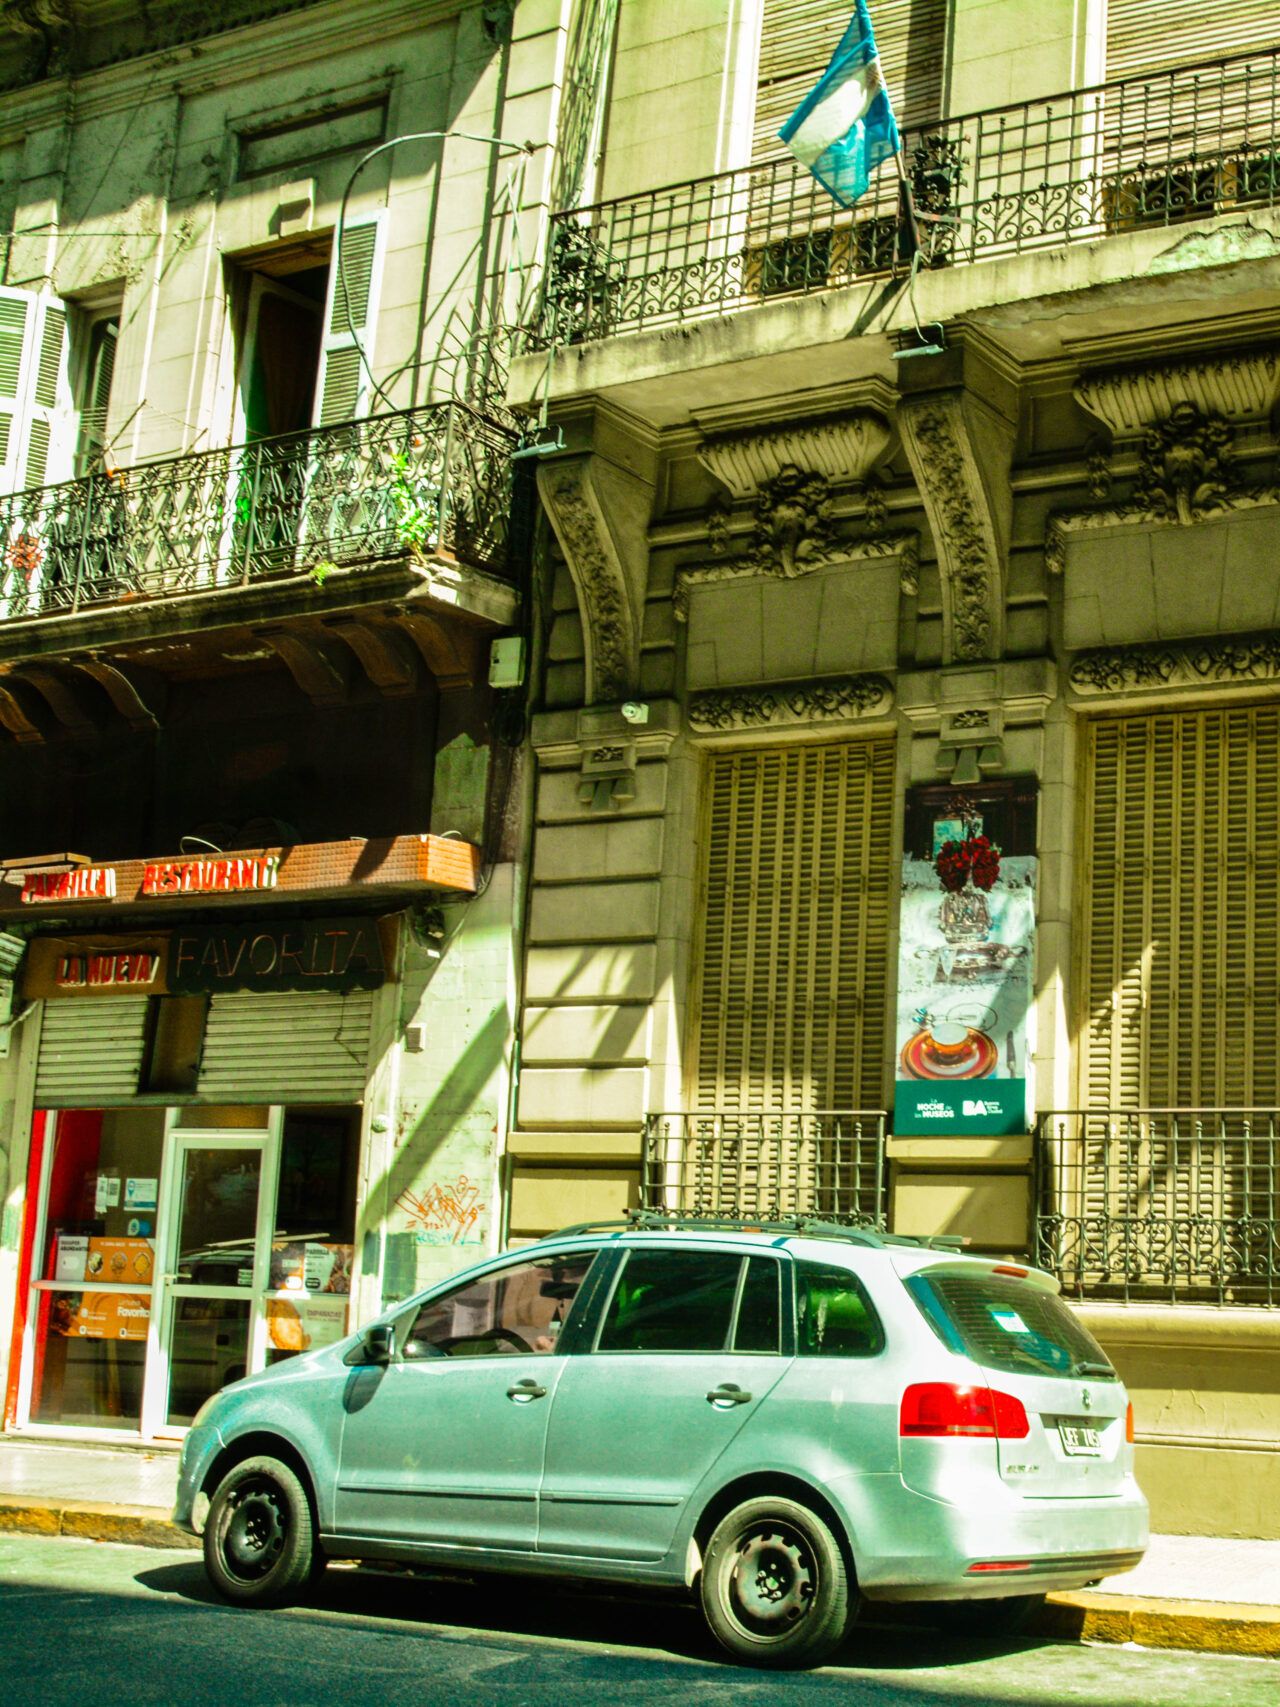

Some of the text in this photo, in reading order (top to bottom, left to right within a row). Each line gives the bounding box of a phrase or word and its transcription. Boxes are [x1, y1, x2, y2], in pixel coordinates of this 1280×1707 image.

[142, 856, 279, 896] RESTAURANT
[176, 930, 385, 978] FAVORITA
[56, 951, 160, 988] LA NUEVA
[917, 1103, 944, 1111] NOCHE
[922, 1110, 954, 1118] MUSEOS
[962, 1100, 987, 1116] BA
